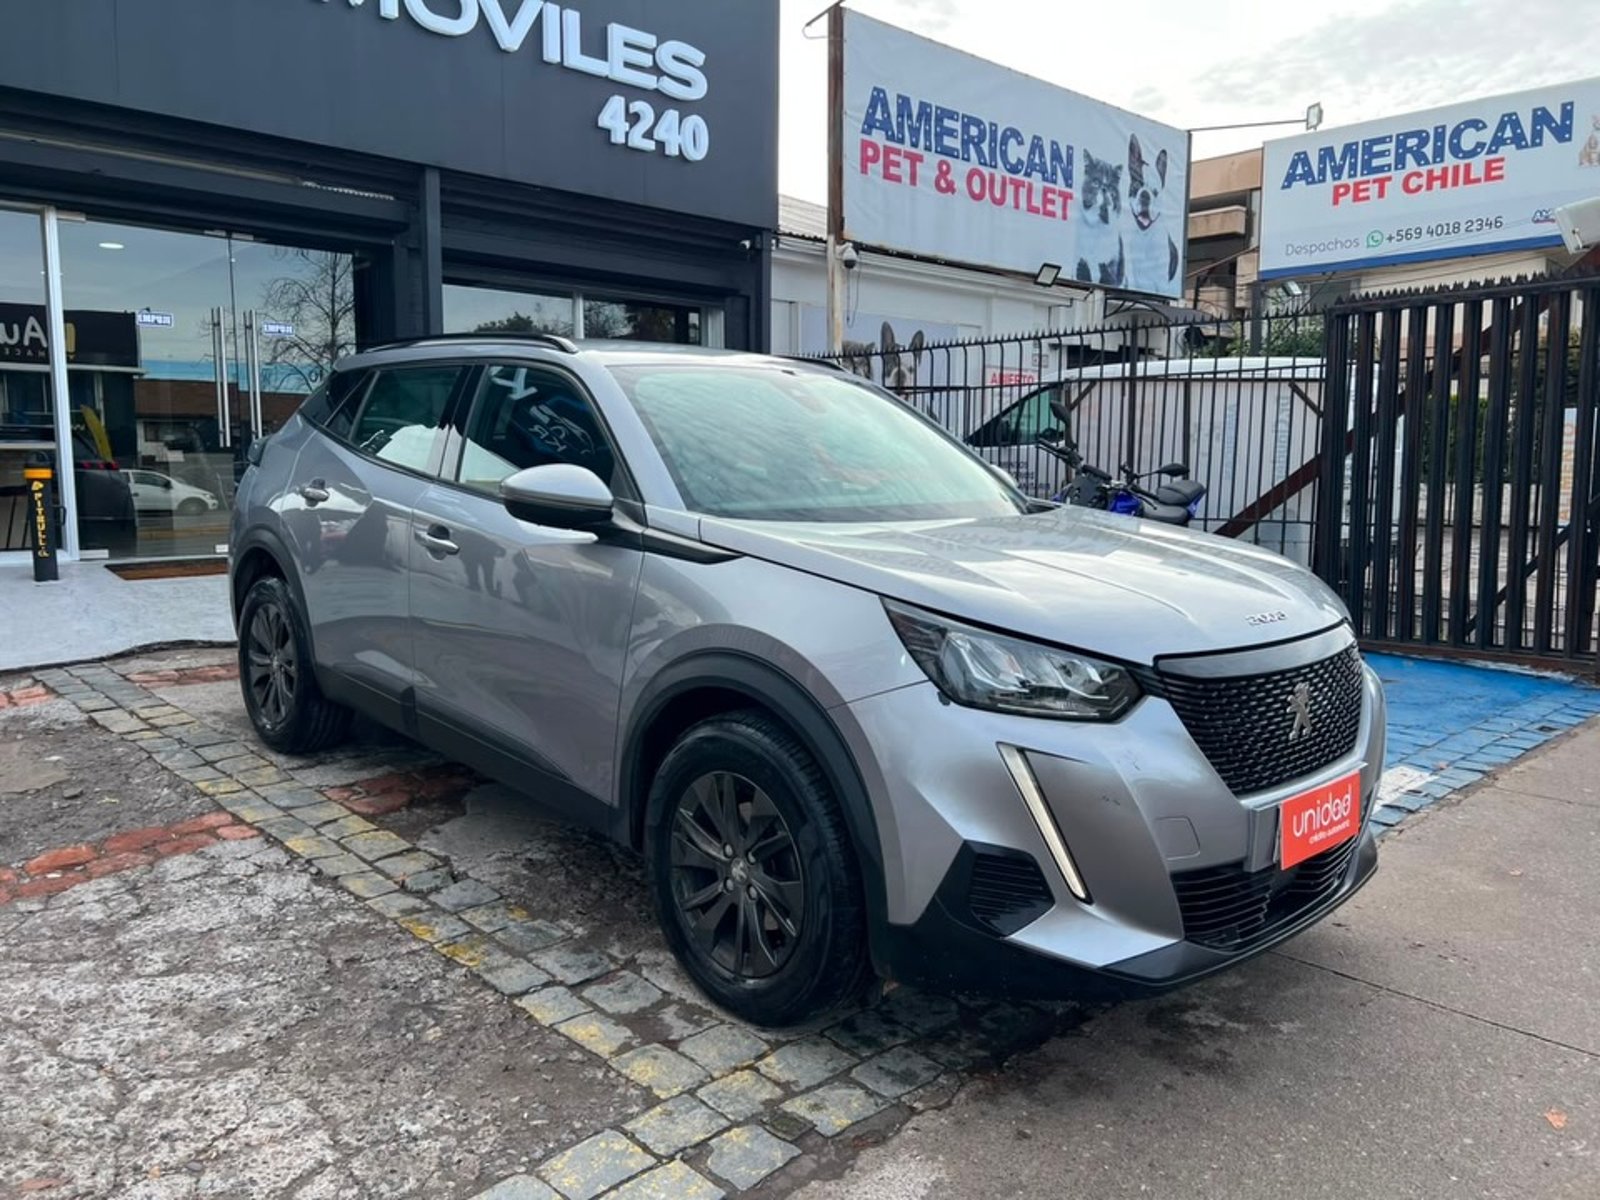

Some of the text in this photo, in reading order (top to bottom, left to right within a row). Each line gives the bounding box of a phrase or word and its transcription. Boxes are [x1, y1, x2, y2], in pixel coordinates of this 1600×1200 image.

[598, 95, 709, 162] 4240
[861, 86, 1074, 188] AMERICAN
[1281, 101, 1574, 190] AMERICAN
[860, 138, 1073, 221] PET & OUTLET
[1332, 157, 1505, 206] PET CHILE
[1285, 216, 1504, 257] Despachos +569 4018 2346
[1292, 783, 1353, 838] unidad
